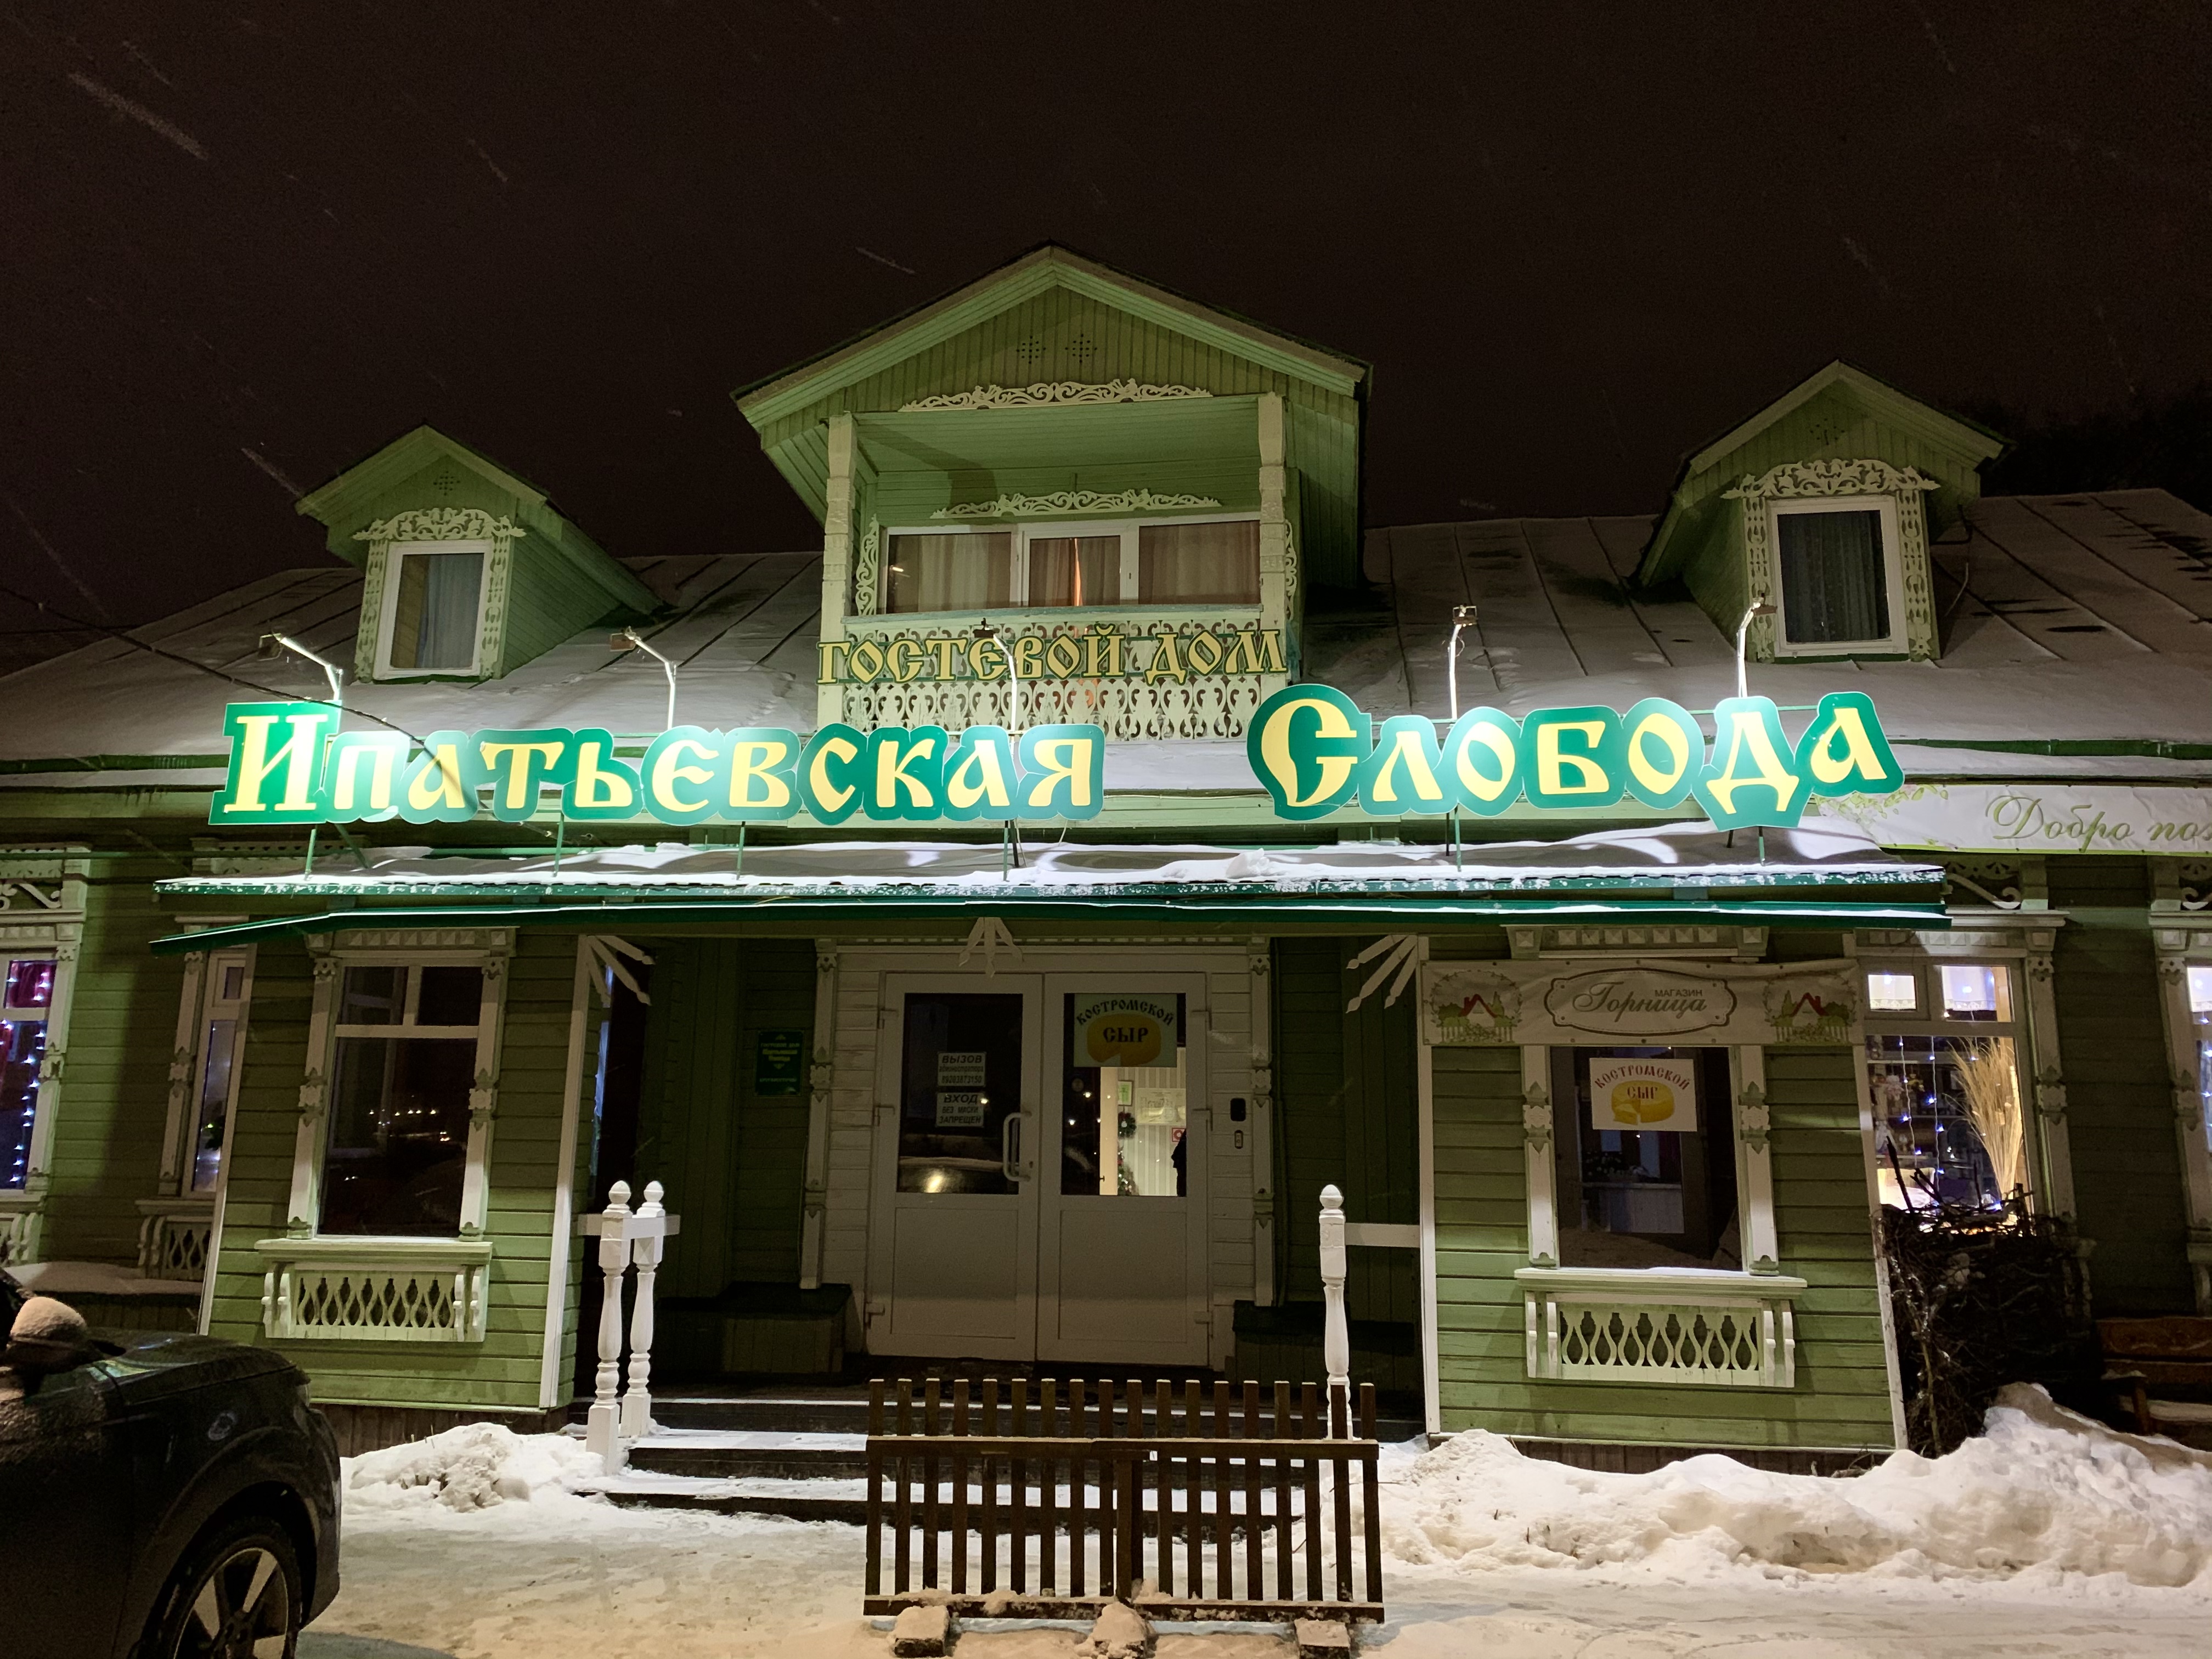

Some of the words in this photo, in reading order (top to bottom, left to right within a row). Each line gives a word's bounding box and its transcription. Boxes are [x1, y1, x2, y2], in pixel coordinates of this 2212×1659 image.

[816, 623, 1126, 685] ГОСТЕВОЙ
[1146, 629, 1289, 686] ДОМ
[1985, 794, 2135, 851] Добро
[1655, 989, 1703, 997] МАГАЗИН
[1572, 981, 1708, 1023] Горница
[1076, 999, 1174, 1026] КОСТРОМСКОЙ
[1103, 1027, 1149, 1043] СЫР
[941, 1055, 982, 1064] ВЫЗОВ
[1594, 1064, 1690, 1090] КОСТРОМСКОЙ
[944, 1094, 979, 1104] ВХОД
[1627, 1086, 1658, 1099] СЫР
[939, 1115, 981, 1125] ЗАПРЕЩЕН
